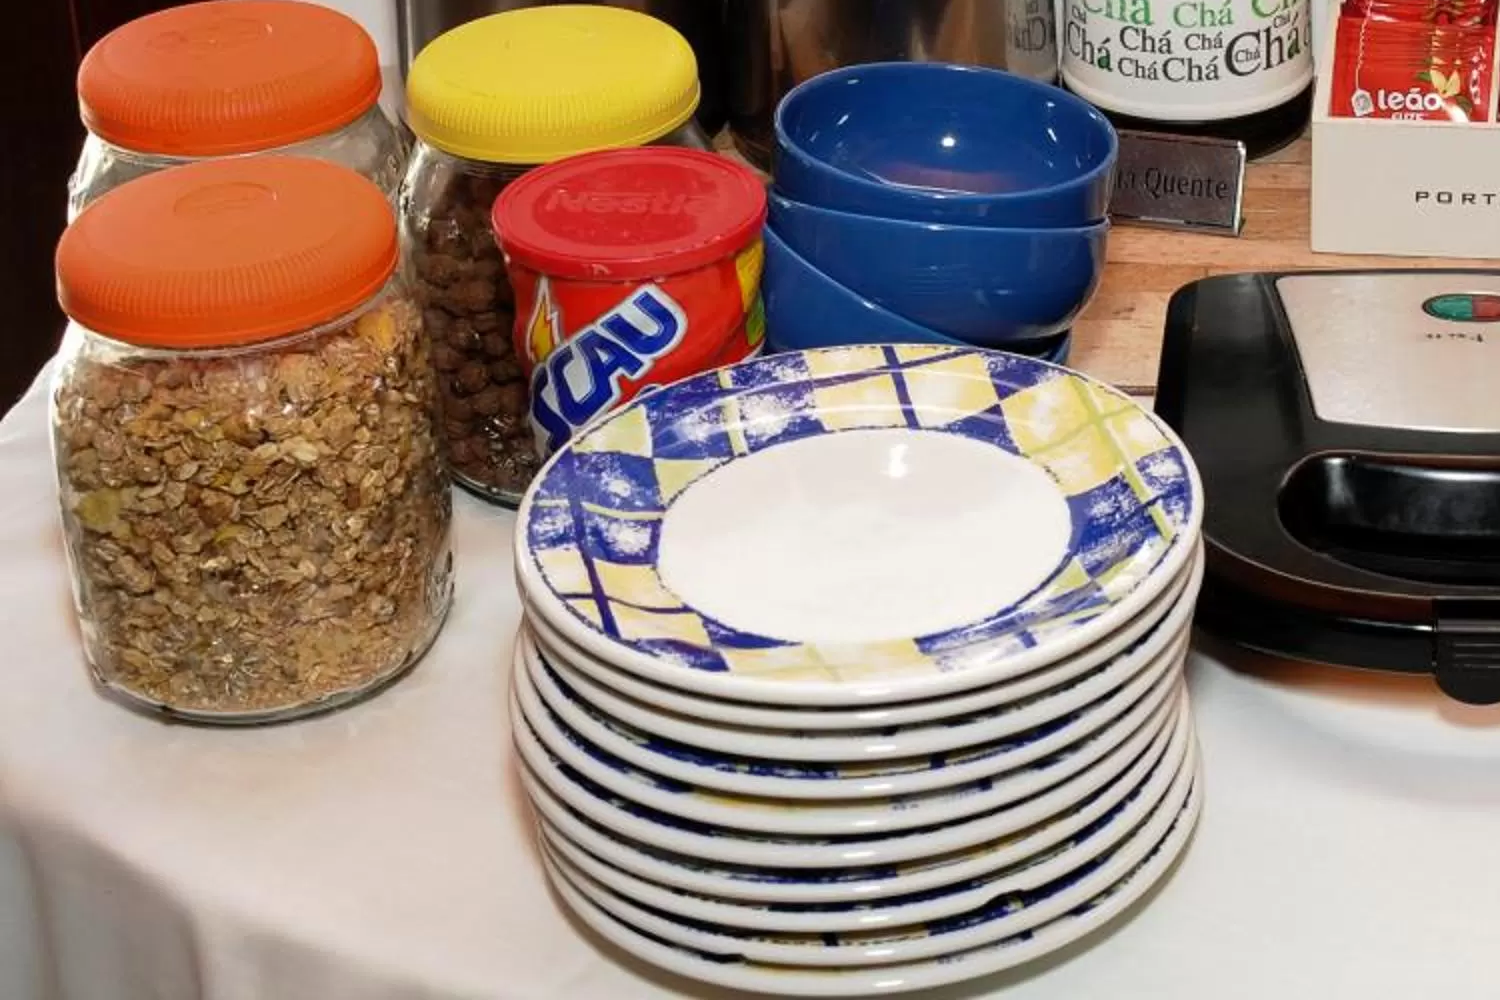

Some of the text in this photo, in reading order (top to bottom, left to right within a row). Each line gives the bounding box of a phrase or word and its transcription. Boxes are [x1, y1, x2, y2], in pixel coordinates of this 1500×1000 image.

[1067, 20, 1113, 72] Chá
[1119, 25, 1173, 54] Chá
[1184, 31, 1224, 51] Chá
[1224, 12, 1301, 77] Chá
[1117, 57, 1159, 81] Chá
[1161, 55, 1221, 83] Chá
[1234, 46, 1262, 64] Chá
[1144, 167, 1229, 200] Quente
